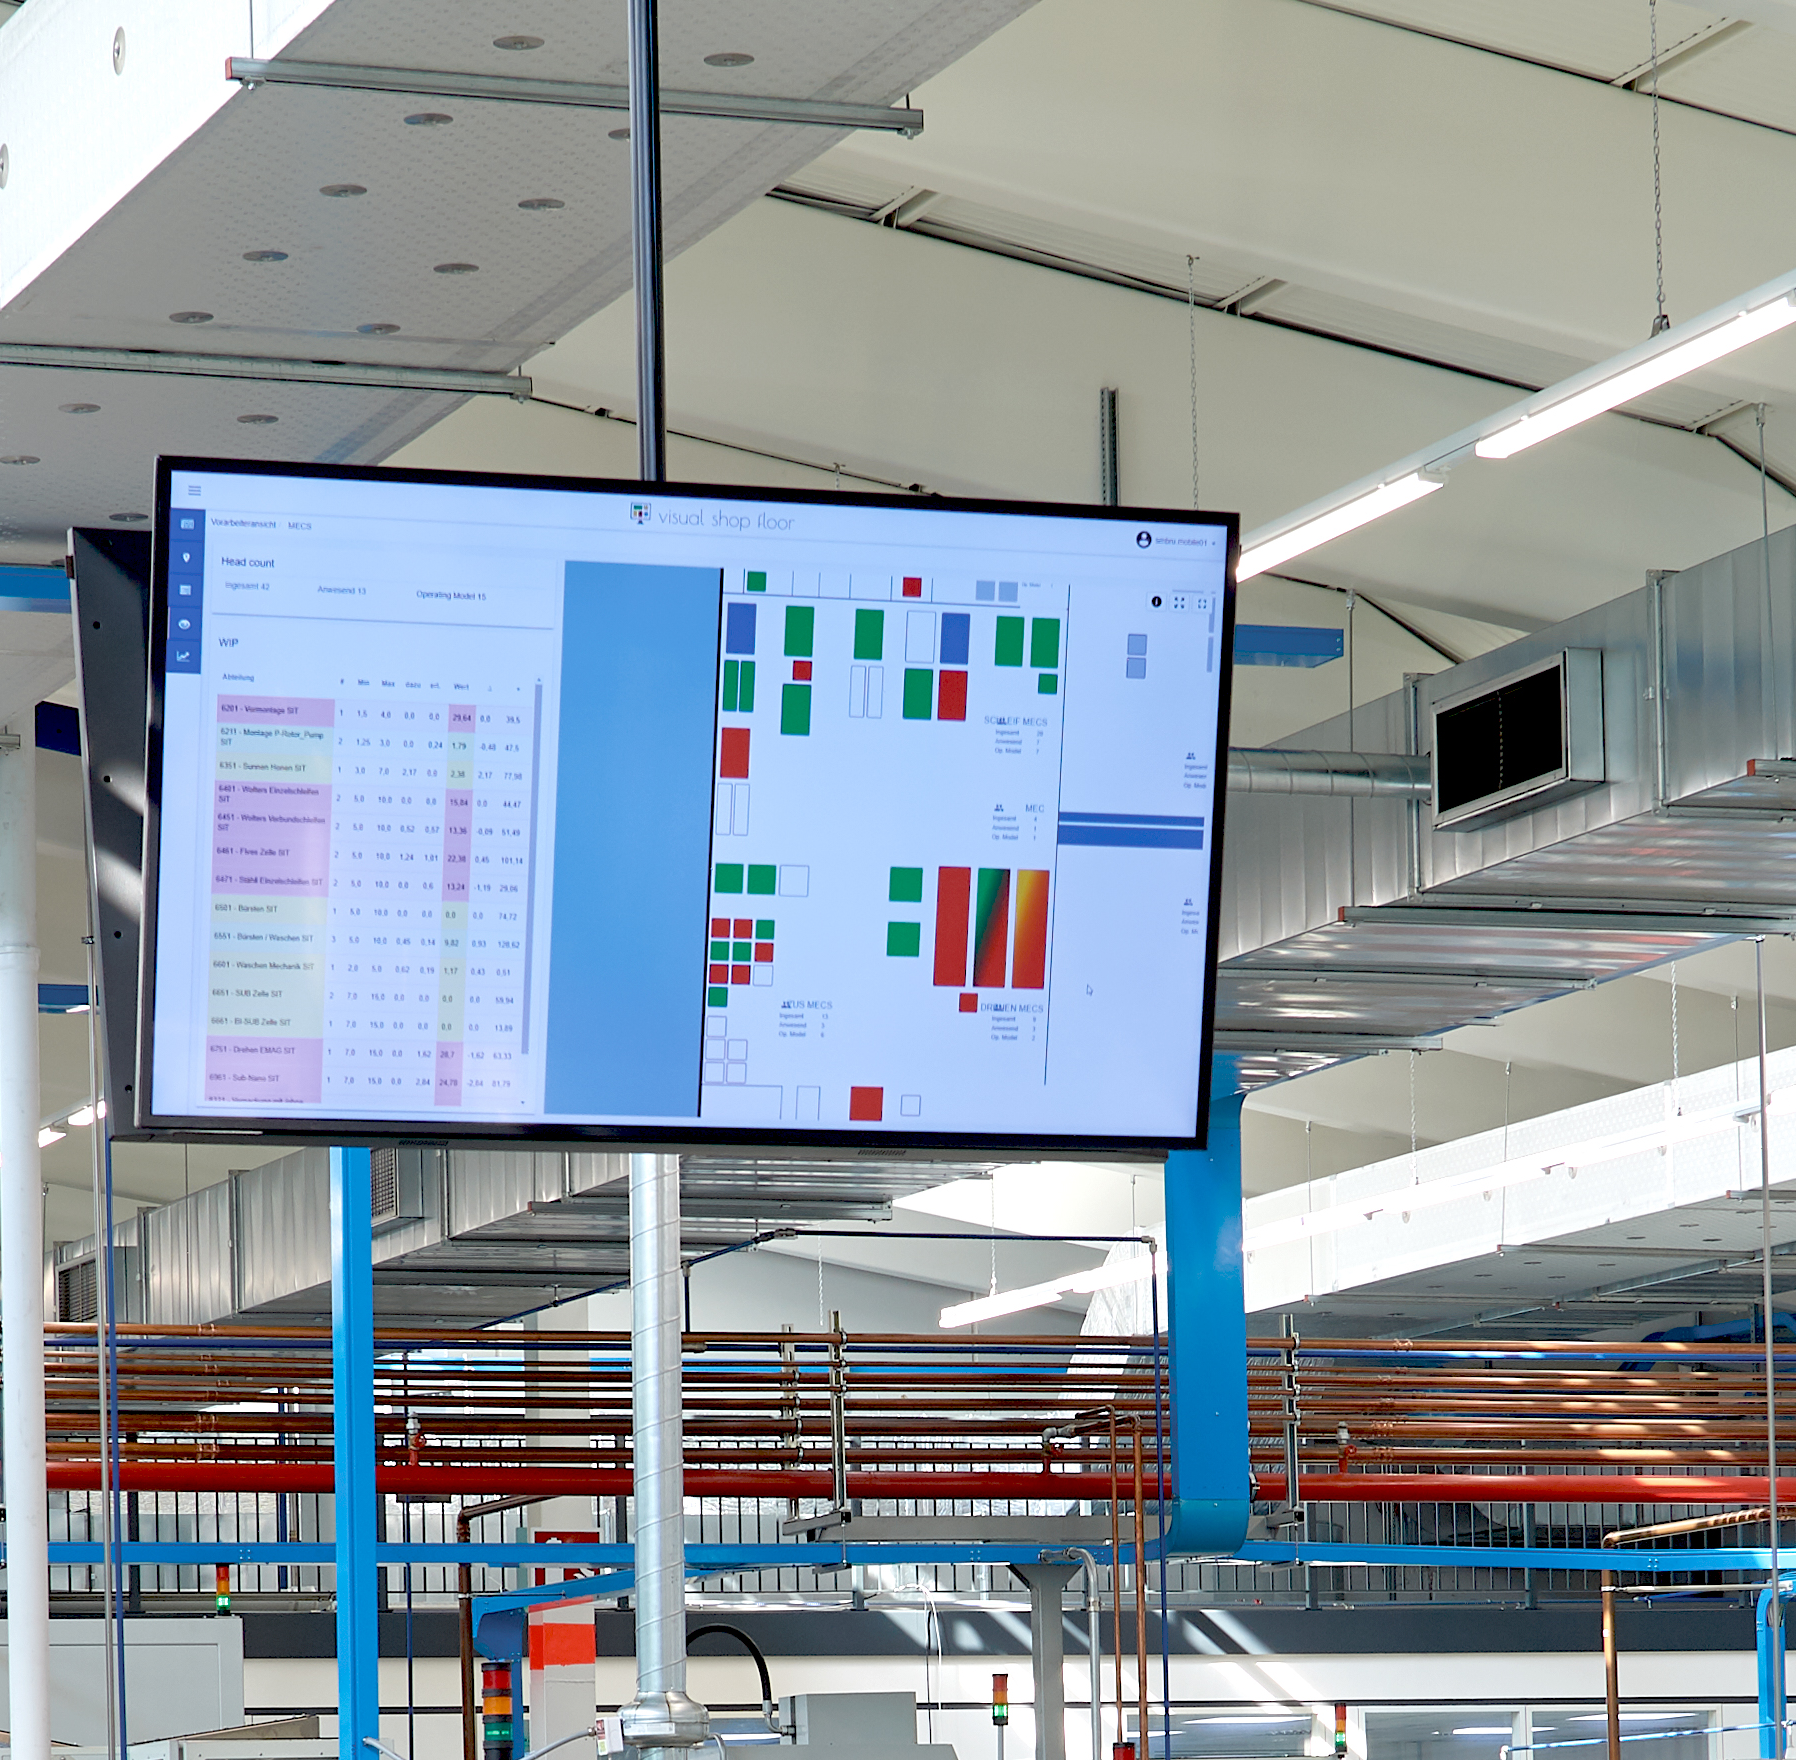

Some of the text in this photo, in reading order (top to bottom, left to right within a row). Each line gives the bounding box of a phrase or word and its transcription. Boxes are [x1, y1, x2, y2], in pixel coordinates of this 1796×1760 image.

[659, 509, 796, 531] visual shop floor
[221, 556, 274, 568] Head count
[218, 638, 239, 647] WIP
